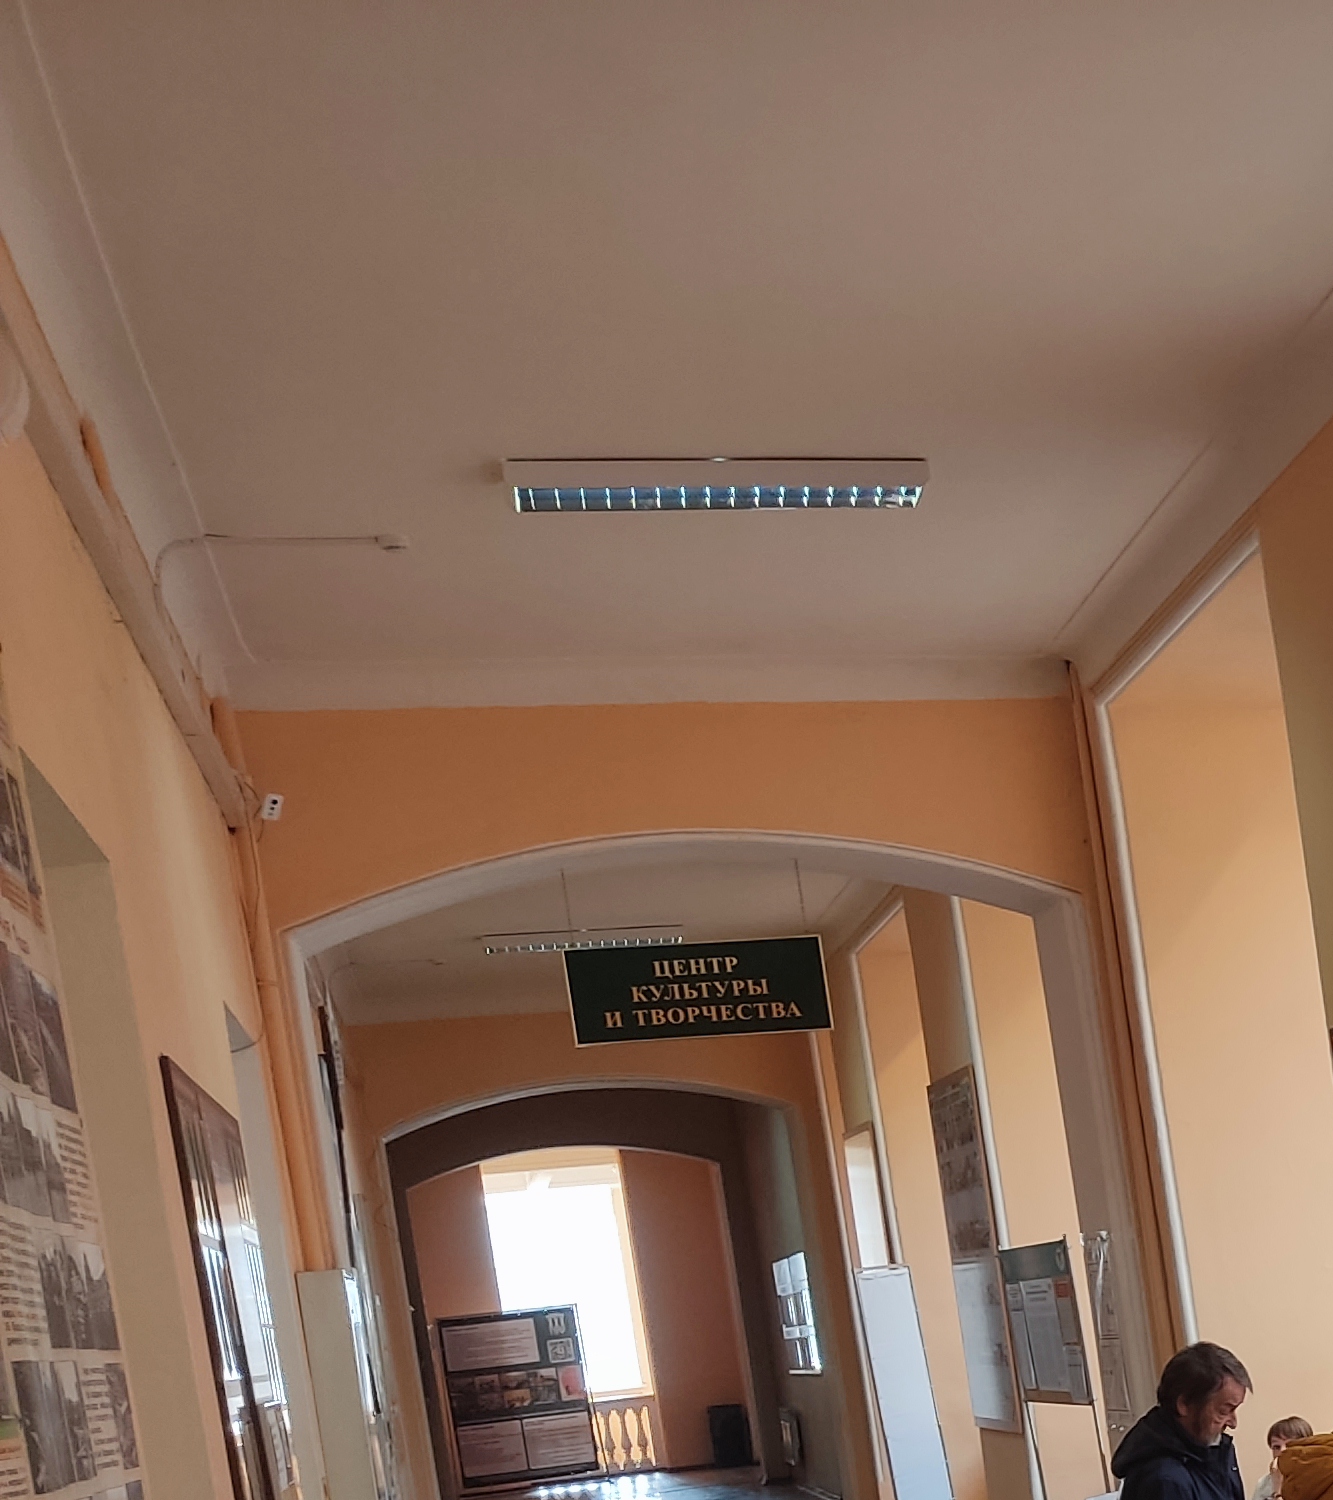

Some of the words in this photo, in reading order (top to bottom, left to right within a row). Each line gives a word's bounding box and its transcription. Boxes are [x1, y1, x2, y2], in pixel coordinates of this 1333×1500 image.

[652, 956, 739, 978] ЦЕНТР
[630, 978, 769, 1003] КУЛЬТУРЫ
[604, 1011, 623, 1028] И
[632, 1001, 803, 1027] ТВОРЧЕСТВА
